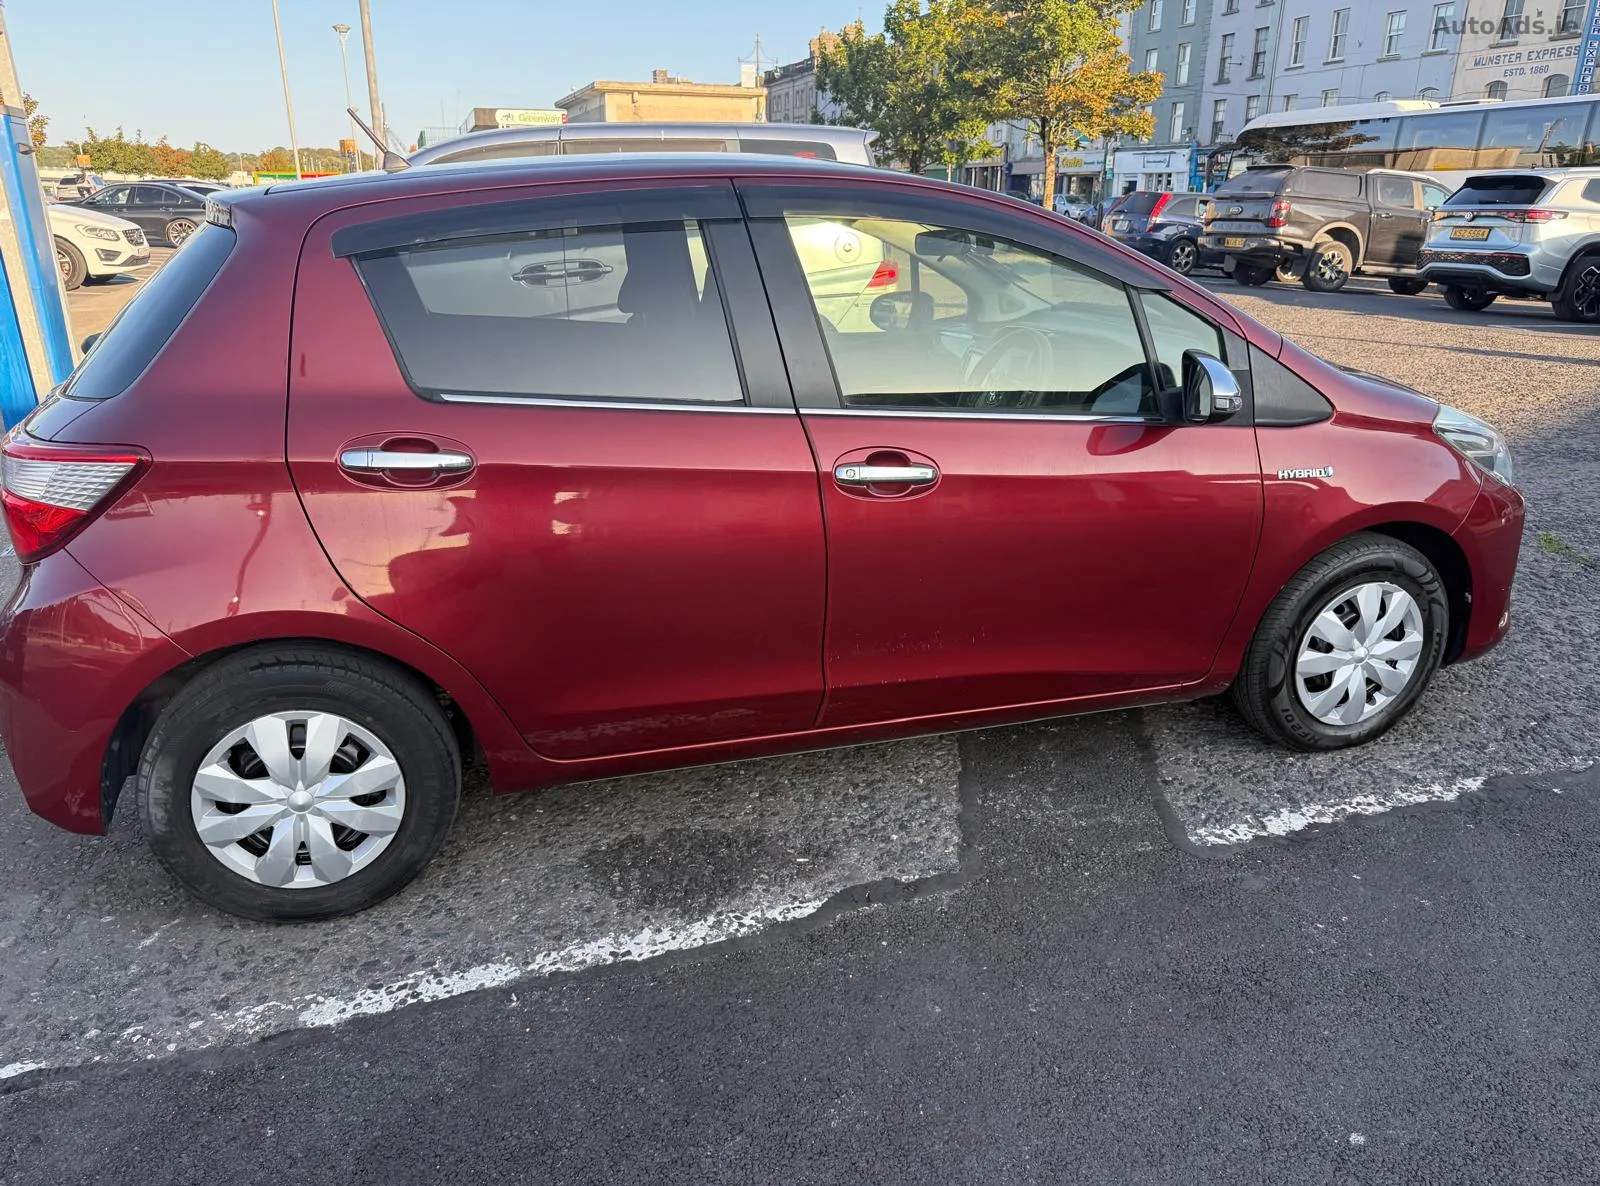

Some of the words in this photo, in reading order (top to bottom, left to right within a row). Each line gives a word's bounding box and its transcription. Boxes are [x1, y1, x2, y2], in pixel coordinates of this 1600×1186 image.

[1474, 54, 1521, 67] MUNSTER
[1527, 45, 1580, 61] EXPRESS
[1504, 67, 1526, 77] ESTD.
[1530, 65, 1549, 75] 1860
[1578, 41, 1598, 95] EXPRES
[1278, 468, 1326, 479] HYBRID
